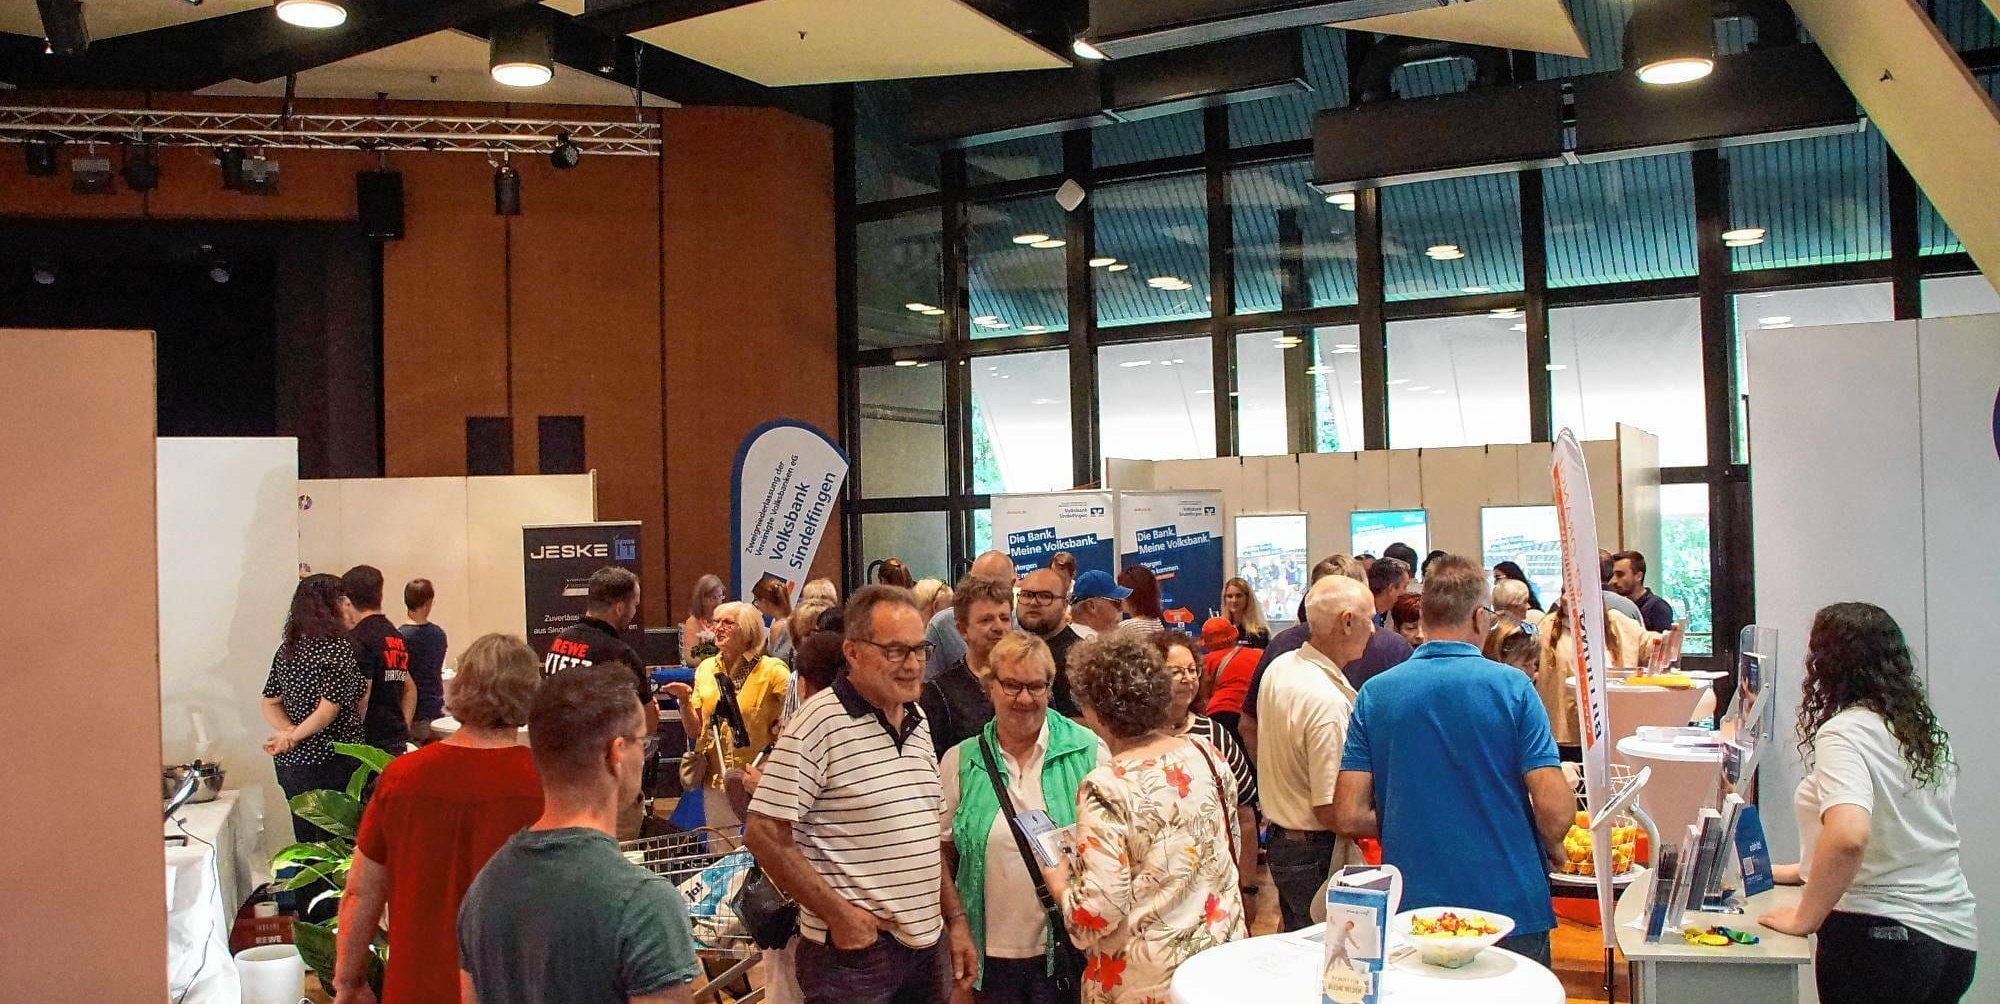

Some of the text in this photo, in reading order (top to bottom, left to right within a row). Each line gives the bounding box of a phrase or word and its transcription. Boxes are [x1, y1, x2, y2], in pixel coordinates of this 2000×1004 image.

[745, 461, 785, 554] Zweigniederlassung der
[755, 454, 799, 556] Vereinigte Volksbanken eG
[769, 482, 811, 560] Volksbank
[789, 472, 836, 569] Sindelfingen
[1009, 529, 1056, 545] Die Bank.
[1137, 527, 1176, 542] Die Bank.
[1139, 533, 1211, 555] Meine Volksbank.
[530, 543, 608, 560] JESKE
[1010, 535, 1098, 557] Meine Volksbank.
[544, 613, 580, 622] Zuverlässi
[551, 637, 590, 658] REWE
[684, 881, 704, 903] ja!
[255, 935, 282, 945] REWE
